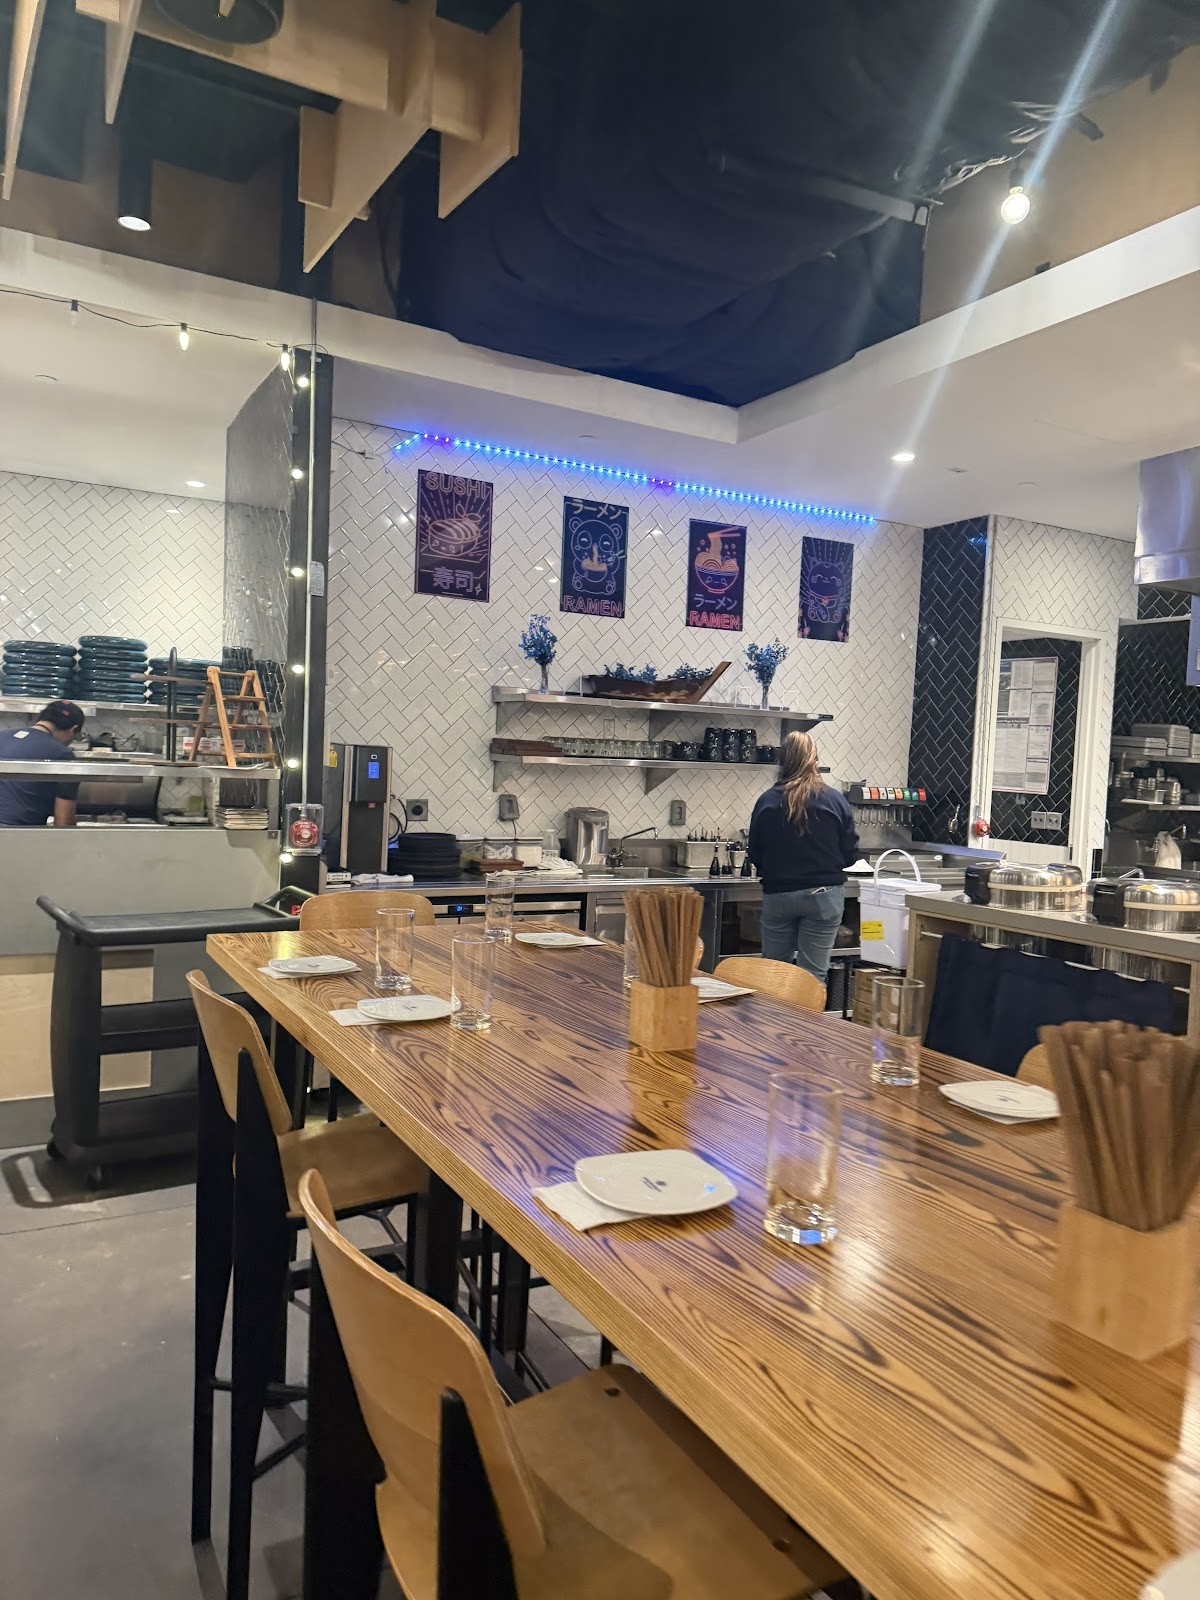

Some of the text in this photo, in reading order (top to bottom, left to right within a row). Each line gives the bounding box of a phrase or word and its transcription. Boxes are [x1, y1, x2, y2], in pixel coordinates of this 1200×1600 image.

[426, 472, 486, 499] SUSHI
[572, 499, 621, 520] ラーメン
[433, 566, 473, 592] 寿司
[563, 595, 622, 617] RAMEN
[694, 593, 737, 610] ラーメン
[689, 610, 740, 630] RAMEN
